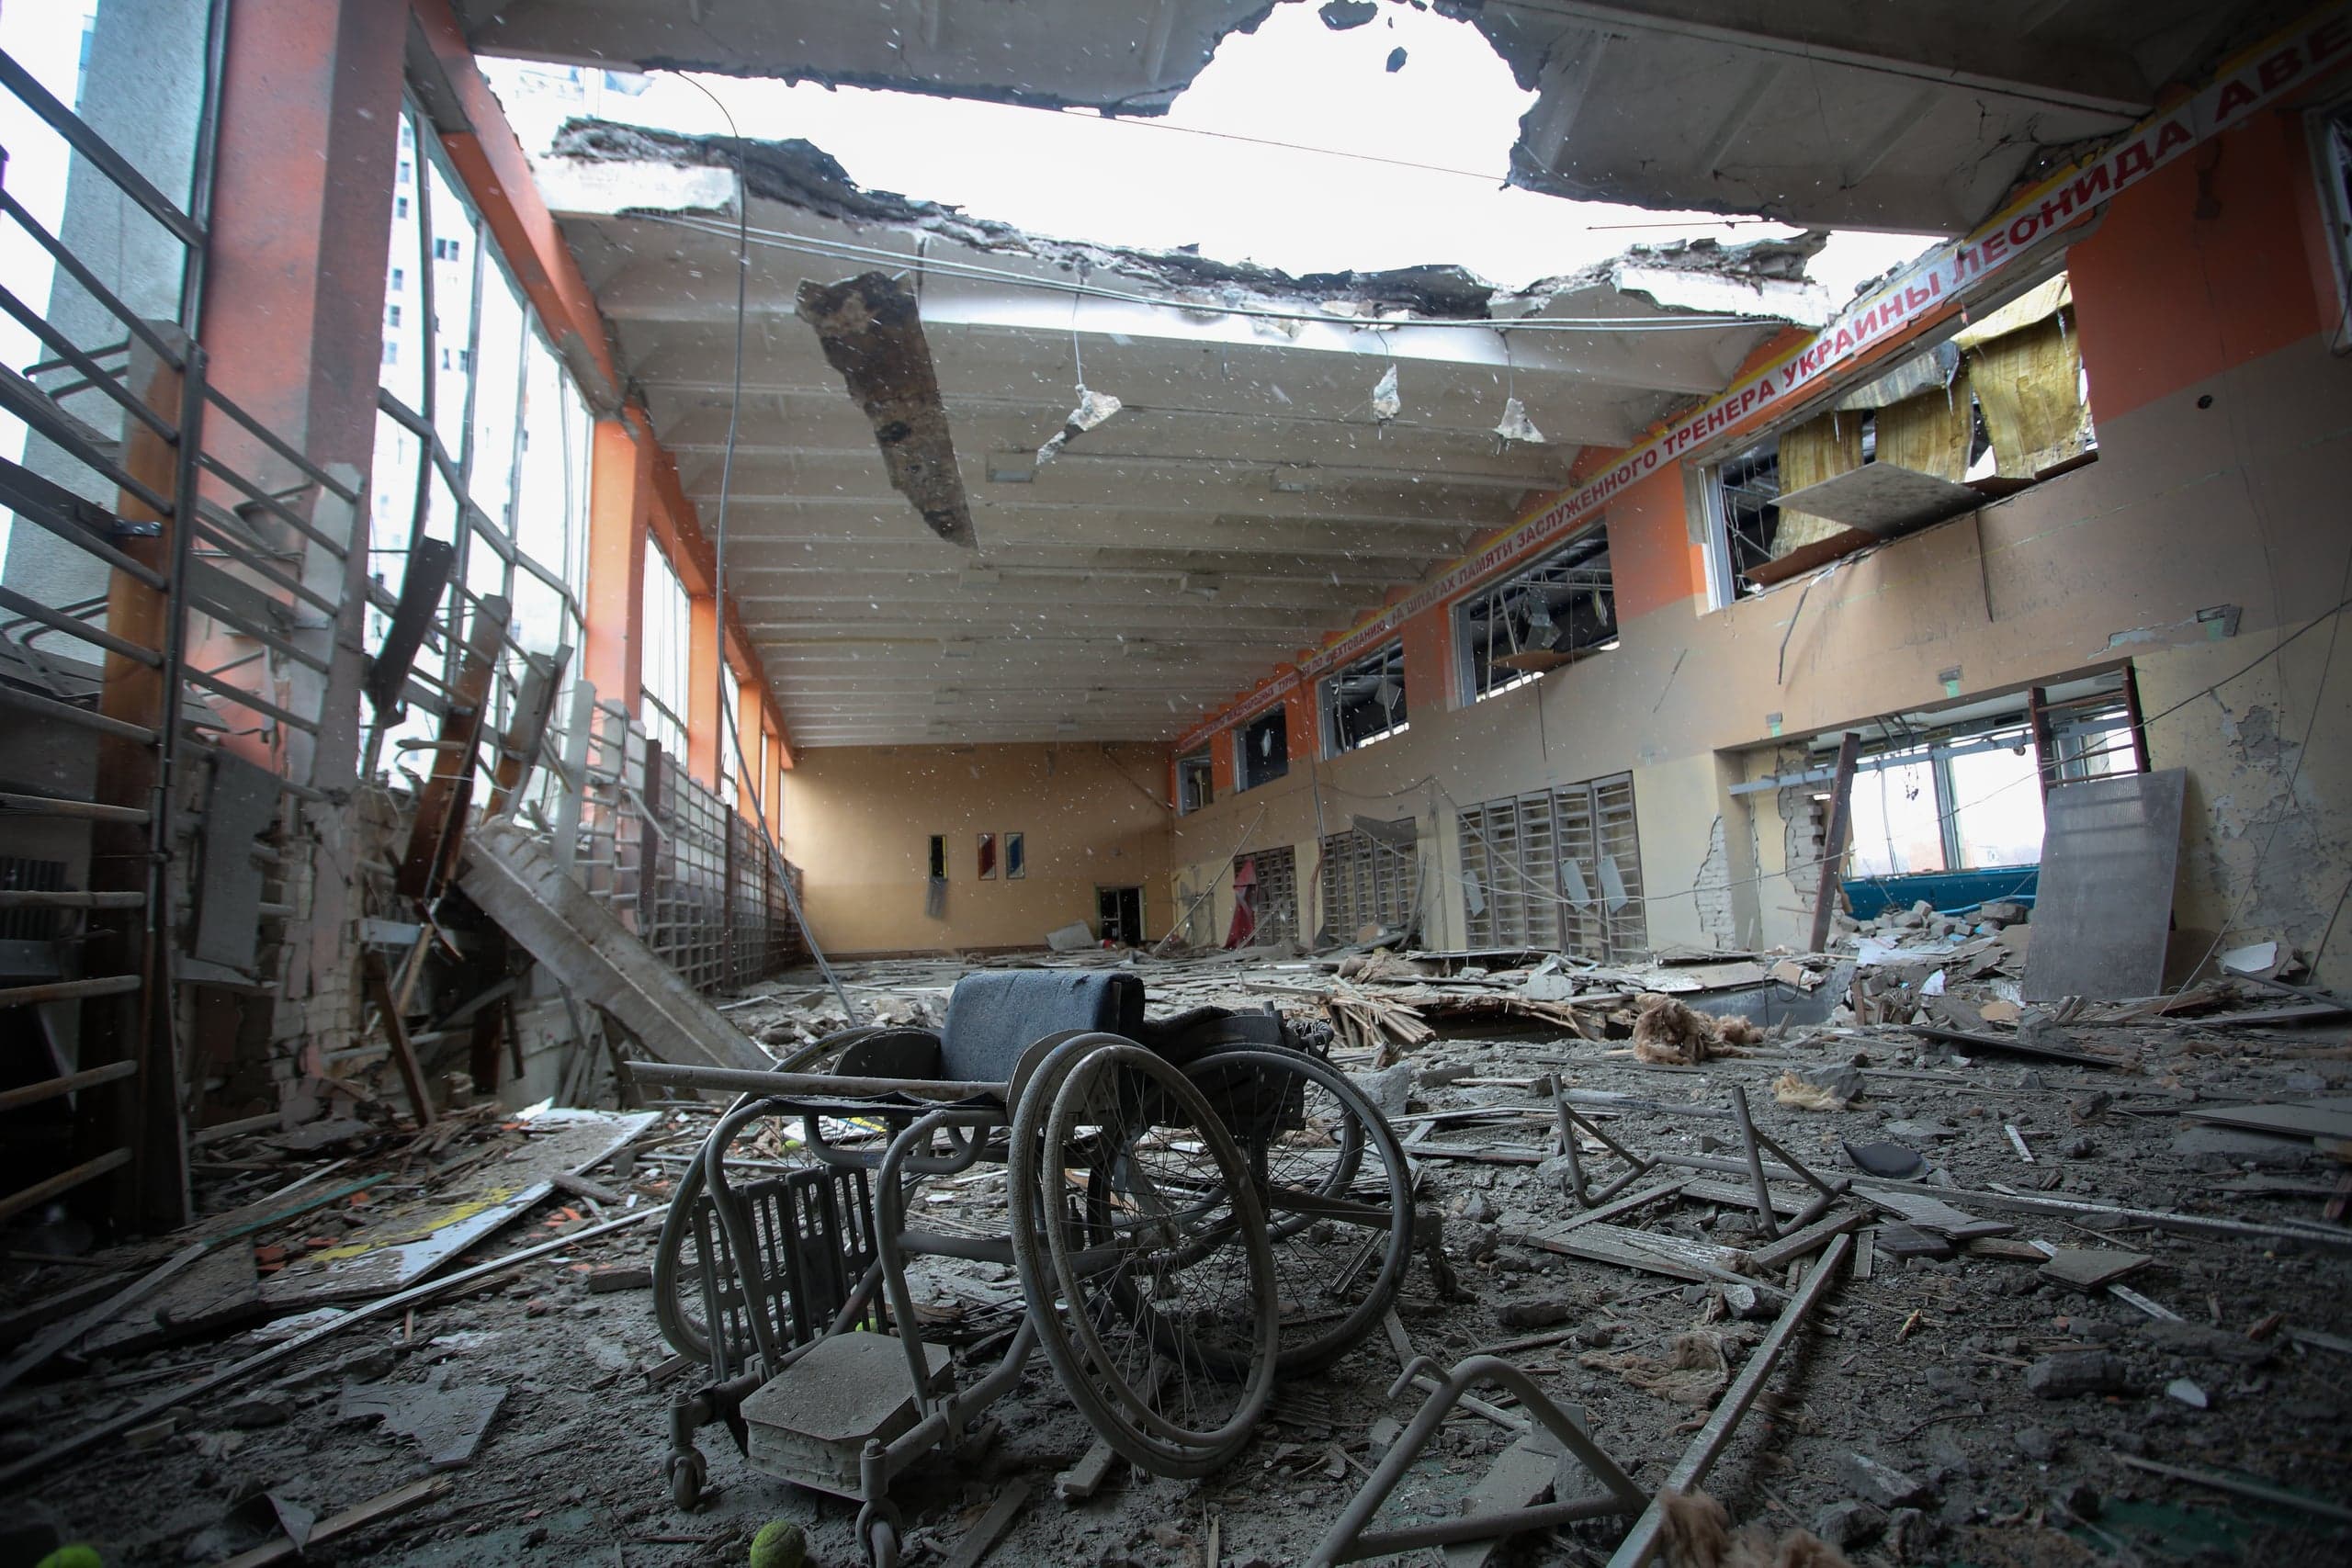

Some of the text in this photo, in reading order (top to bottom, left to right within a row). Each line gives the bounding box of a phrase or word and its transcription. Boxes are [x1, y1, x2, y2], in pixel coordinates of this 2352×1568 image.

[1408, 579, 1456, 615] ШПАГАХ
[1459, 540, 1514, 586] ПАМЯТИ
[1517, 450, 1657, 546] ЗАСЛУЖЕННОГО
[1664, 379, 1776, 456] ТРЕНЕРА
[1781, 271, 1941, 388] УКРАИНЫ
[1952, 119, 2193, 285] ЛЕОНИДА
